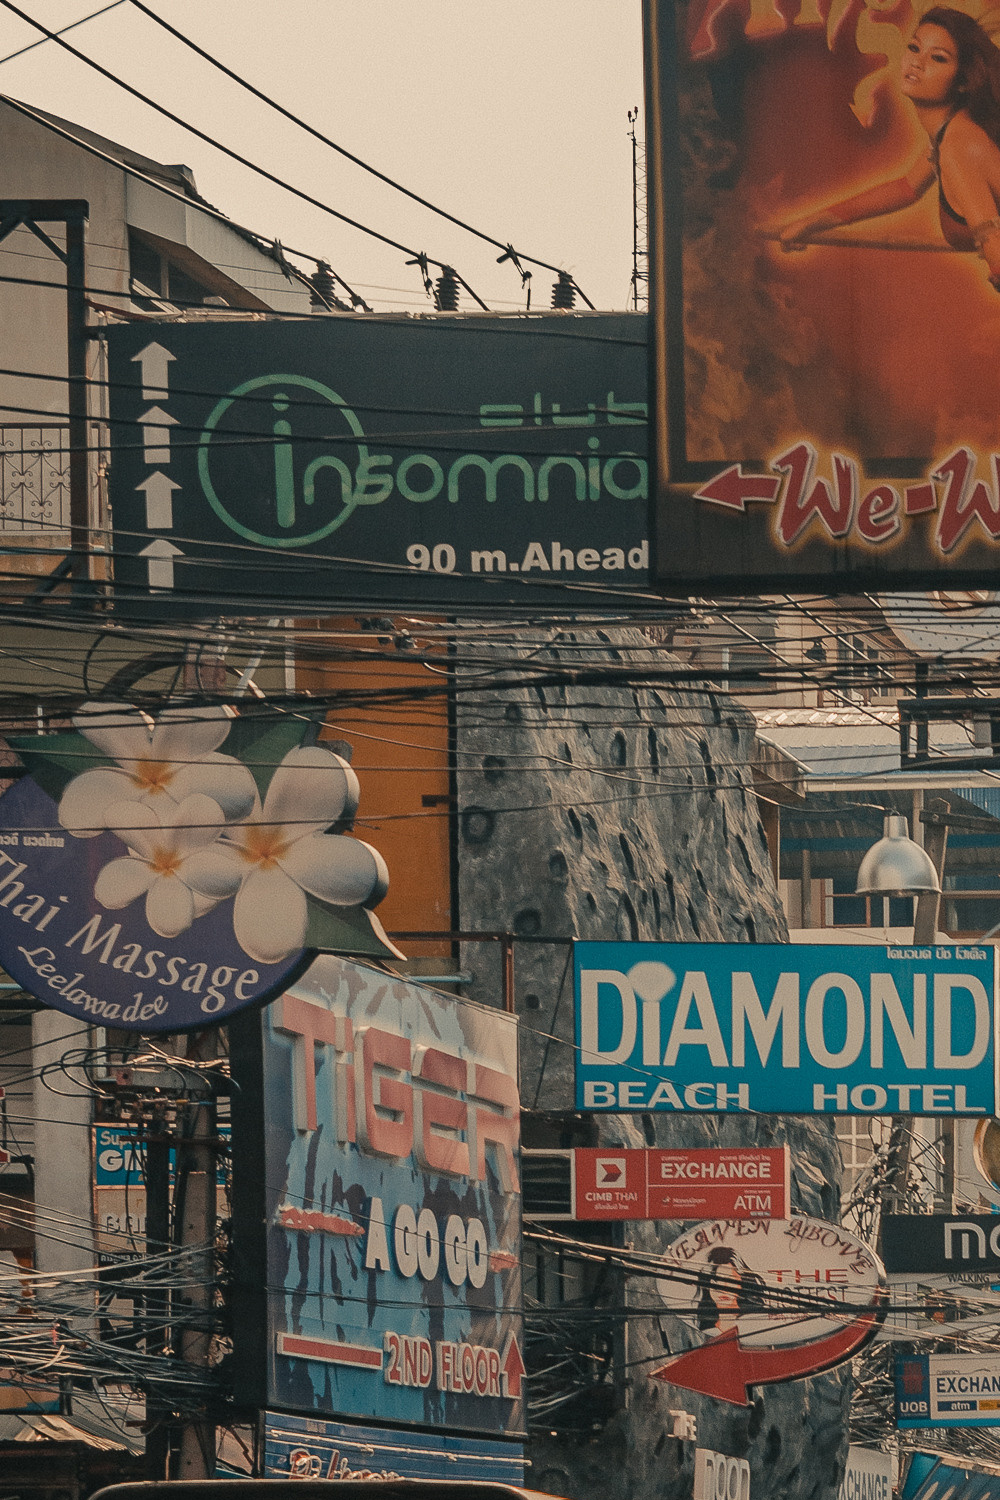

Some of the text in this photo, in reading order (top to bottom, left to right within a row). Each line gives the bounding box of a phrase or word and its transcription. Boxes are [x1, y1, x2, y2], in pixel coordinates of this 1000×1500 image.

[406, 544, 455, 574] 90
[65, 914, 260, 1013] Massage
[582, 1081, 987, 1112] BEACH HOTEL
[661, 1163, 771, 1179] EXCHANGE
[585, 1191, 638, 1202] CIMB THAI
[734, 1195, 771, 1210] ATM
[364, 1197, 488, 1290] A GO GO
[768, 1269, 849, 1283] THE
[949, 1274, 989, 1284] WALKING
[384, 1330, 501, 1397] 2ND FLOOR
[900, 1401, 928, 1413] UOB
[951, 1401, 971, 1411] atm
